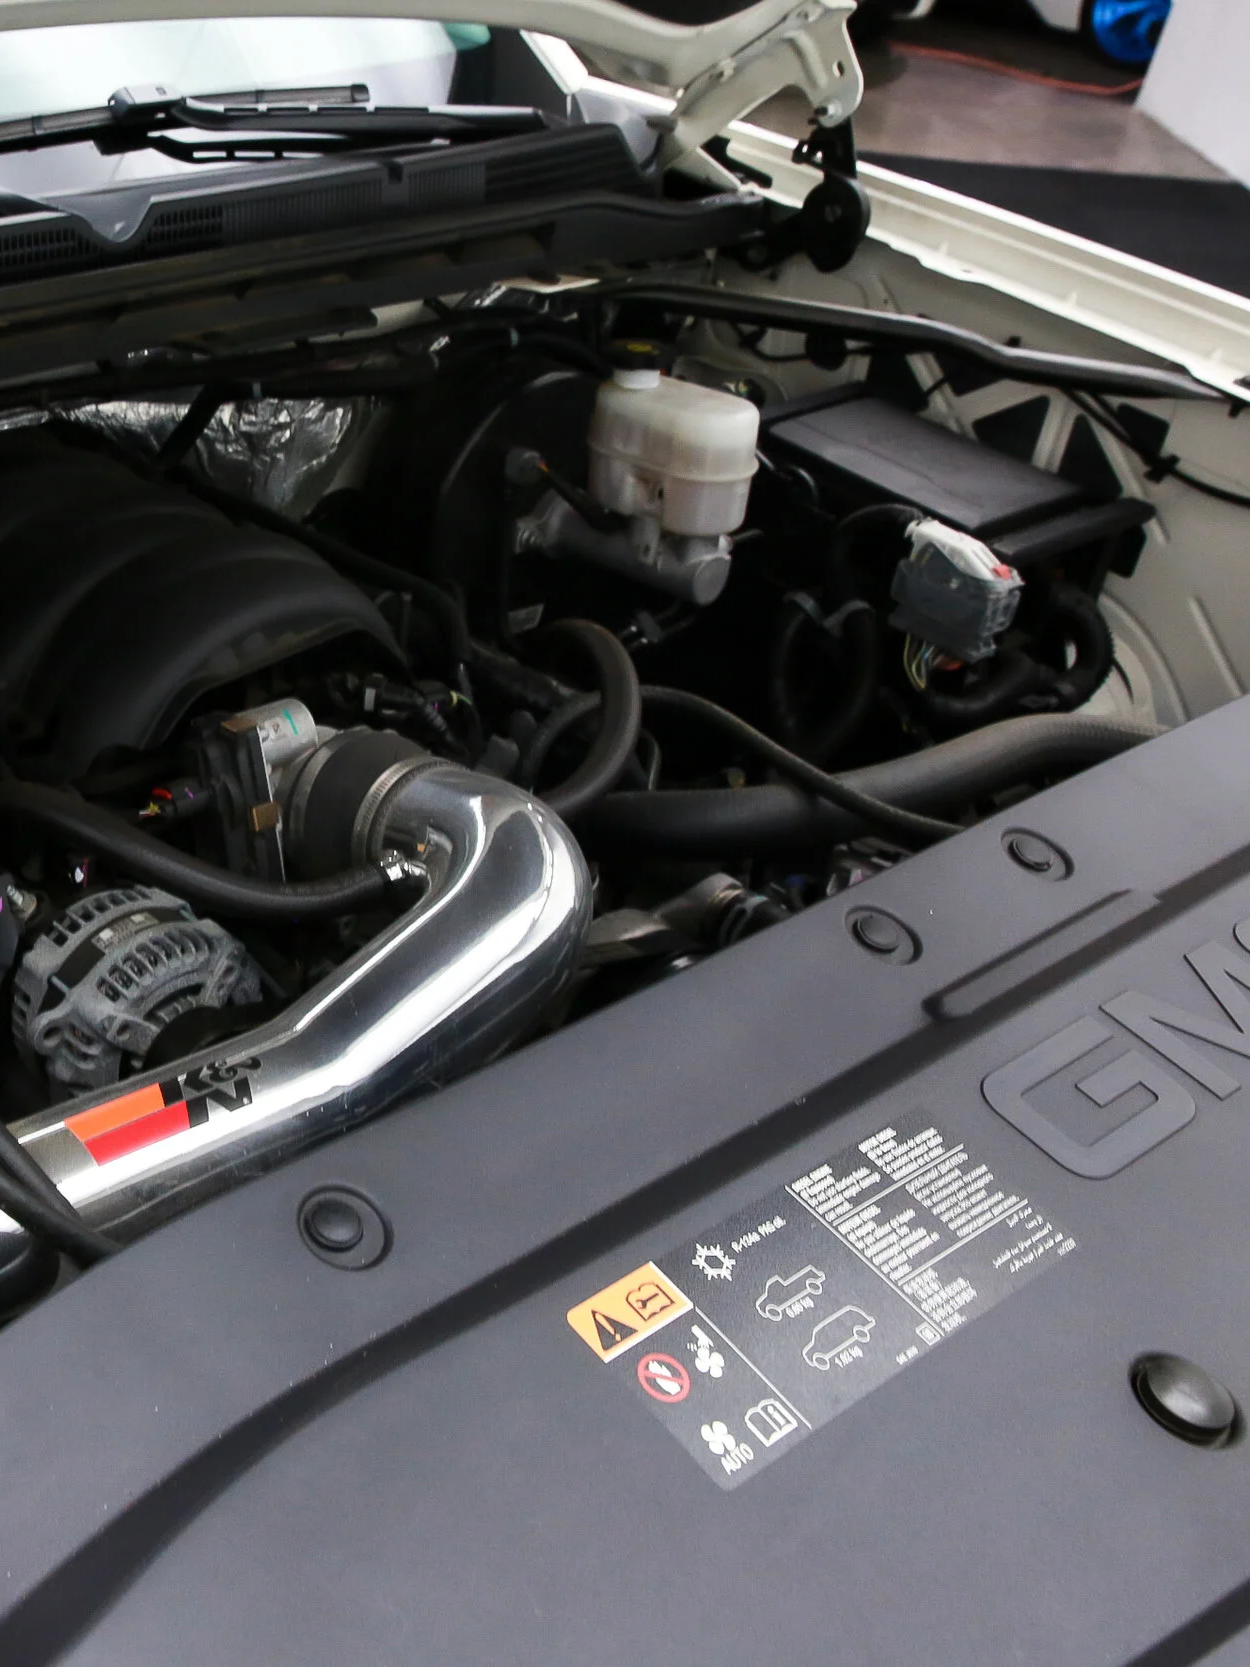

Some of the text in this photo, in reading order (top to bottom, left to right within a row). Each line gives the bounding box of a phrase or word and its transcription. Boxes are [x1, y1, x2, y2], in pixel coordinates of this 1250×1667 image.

[980, 918, 1250, 1180] GM
[731, 1232, 760, 1253] R-134a
[720, 1442, 754, 1474] AUTO
